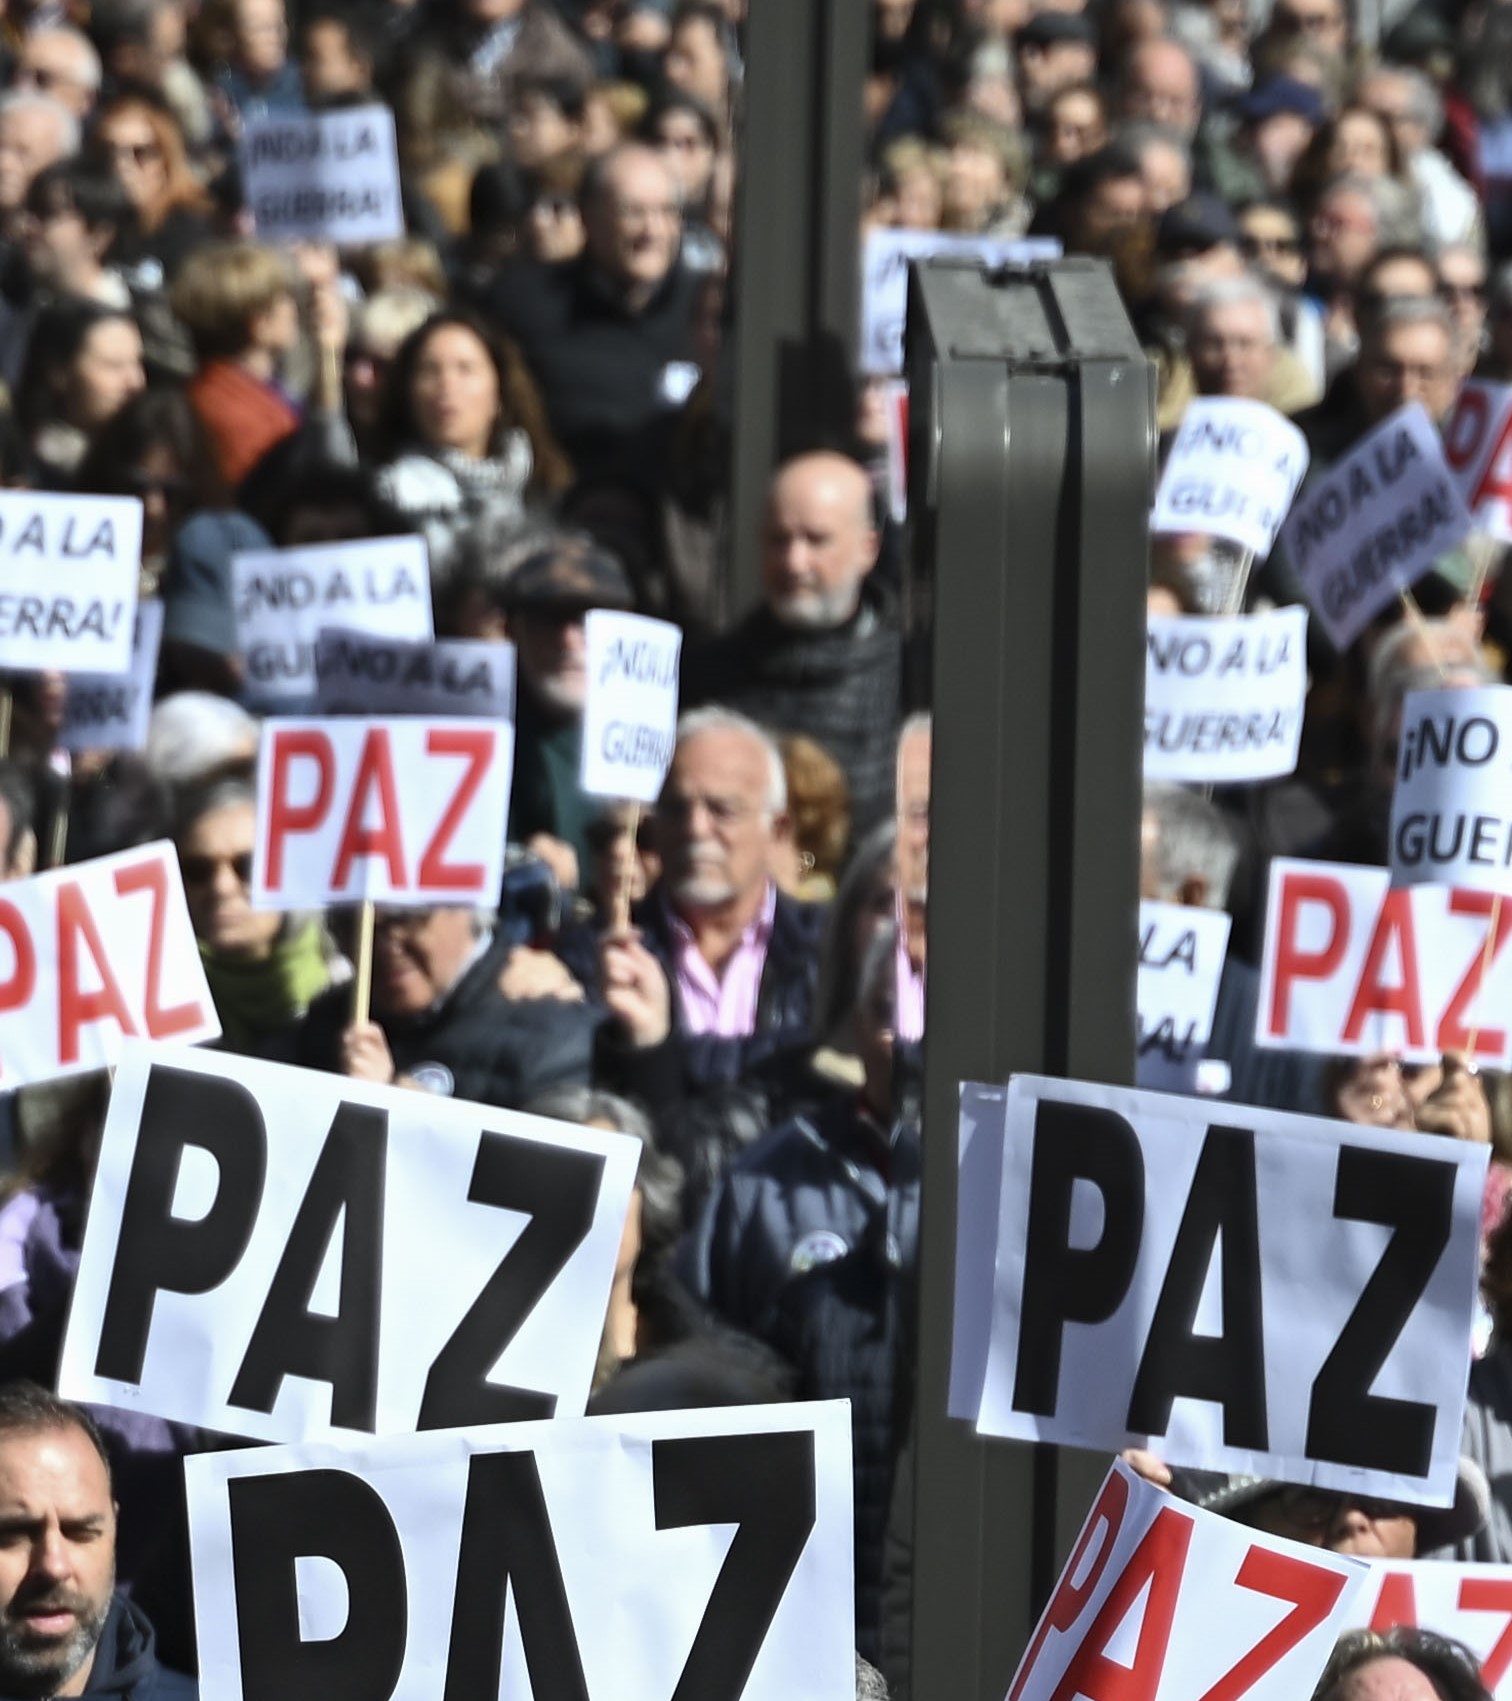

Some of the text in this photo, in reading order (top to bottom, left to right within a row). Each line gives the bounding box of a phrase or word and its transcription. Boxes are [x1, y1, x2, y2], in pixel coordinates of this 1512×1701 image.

[21, 515, 49, 557] A
[58, 516, 117, 560] LA
[263, 729, 496, 893] PAZ
[1401, 715, 1500, 782] ¡NO
[94, 1063, 607, 1433] PAZ
[1012, 1099, 1459, 1478] PAZ
